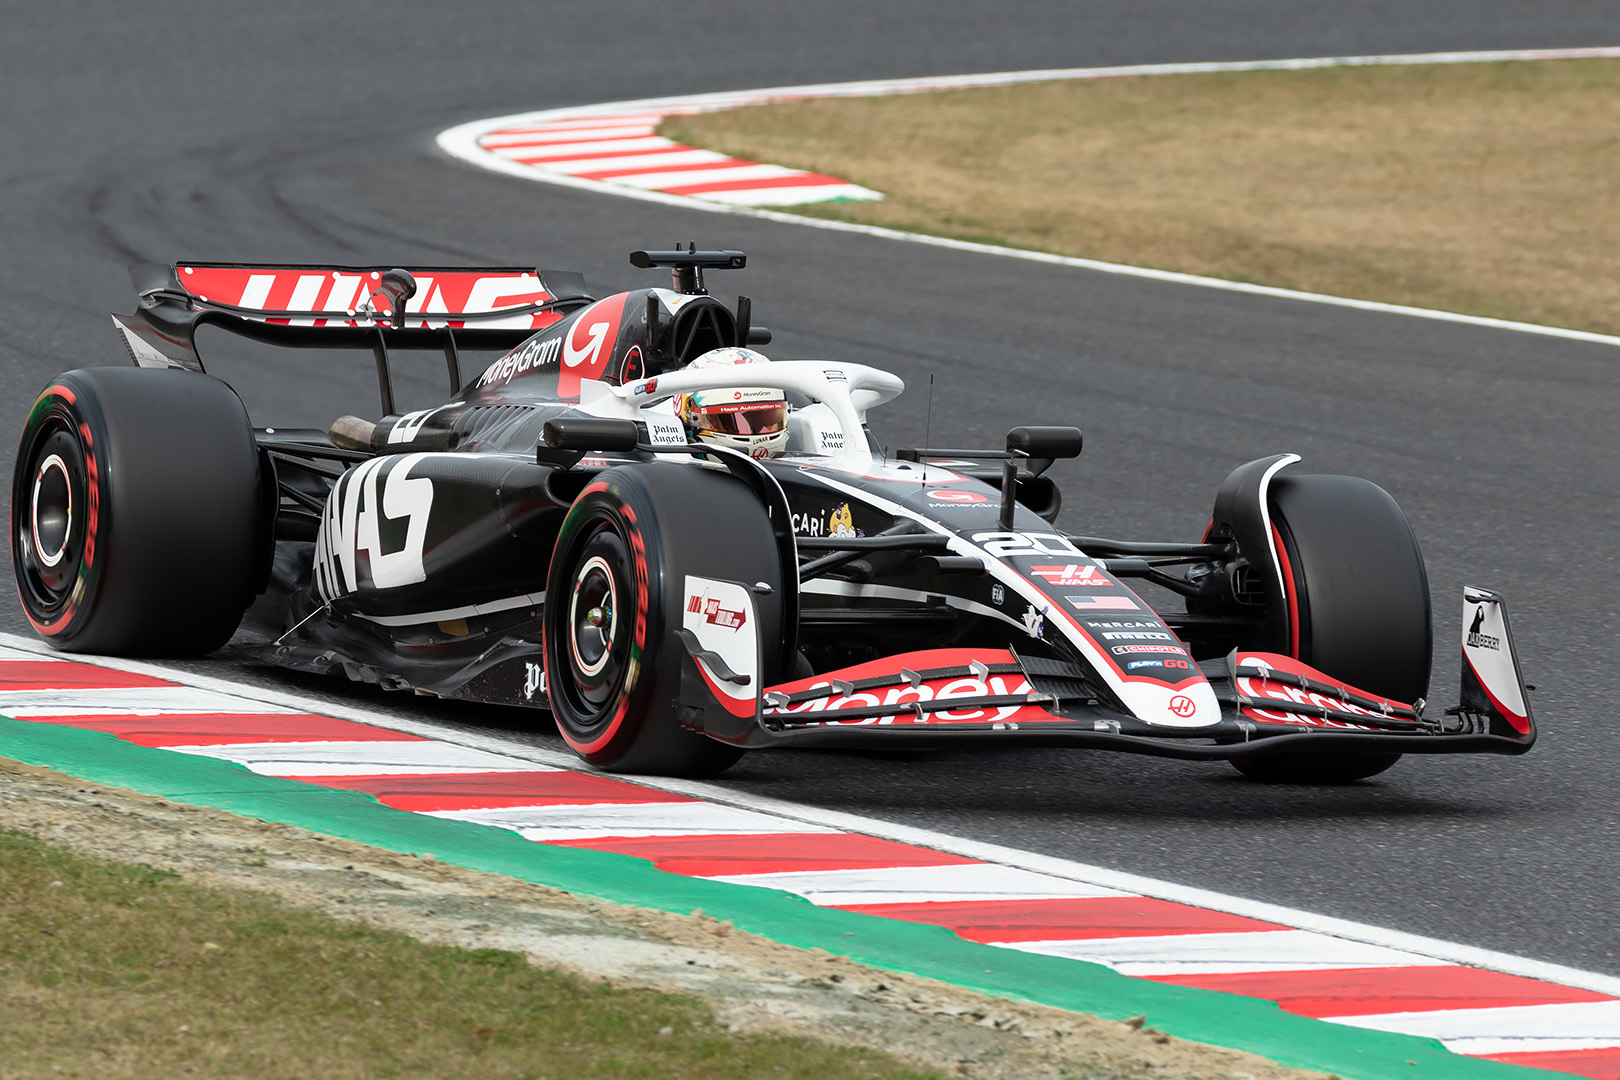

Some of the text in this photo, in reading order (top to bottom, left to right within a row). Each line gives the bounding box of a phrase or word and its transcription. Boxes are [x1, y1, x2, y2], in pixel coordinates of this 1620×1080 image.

[475, 336, 562, 389] MoneyGram
[653, 425, 678, 435] Palm
[653, 434, 685, 444] Angels
[753, 436, 768, 445] LUNAR
[820, 440, 844, 449] Ange
[84, 451, 100, 570] ZERO
[929, 502, 1019, 510] MoneyGra
[792, 509, 826, 538] CARI
[971, 532, 1088, 559] 20
[629, 527, 649, 651] ZERO
[1101, 632, 1172, 640] PIRELLI
[1128, 646, 1184, 655] CHIPOTLE
[1163, 659, 1189, 669] GO
[763, 676, 1037, 726] Money
